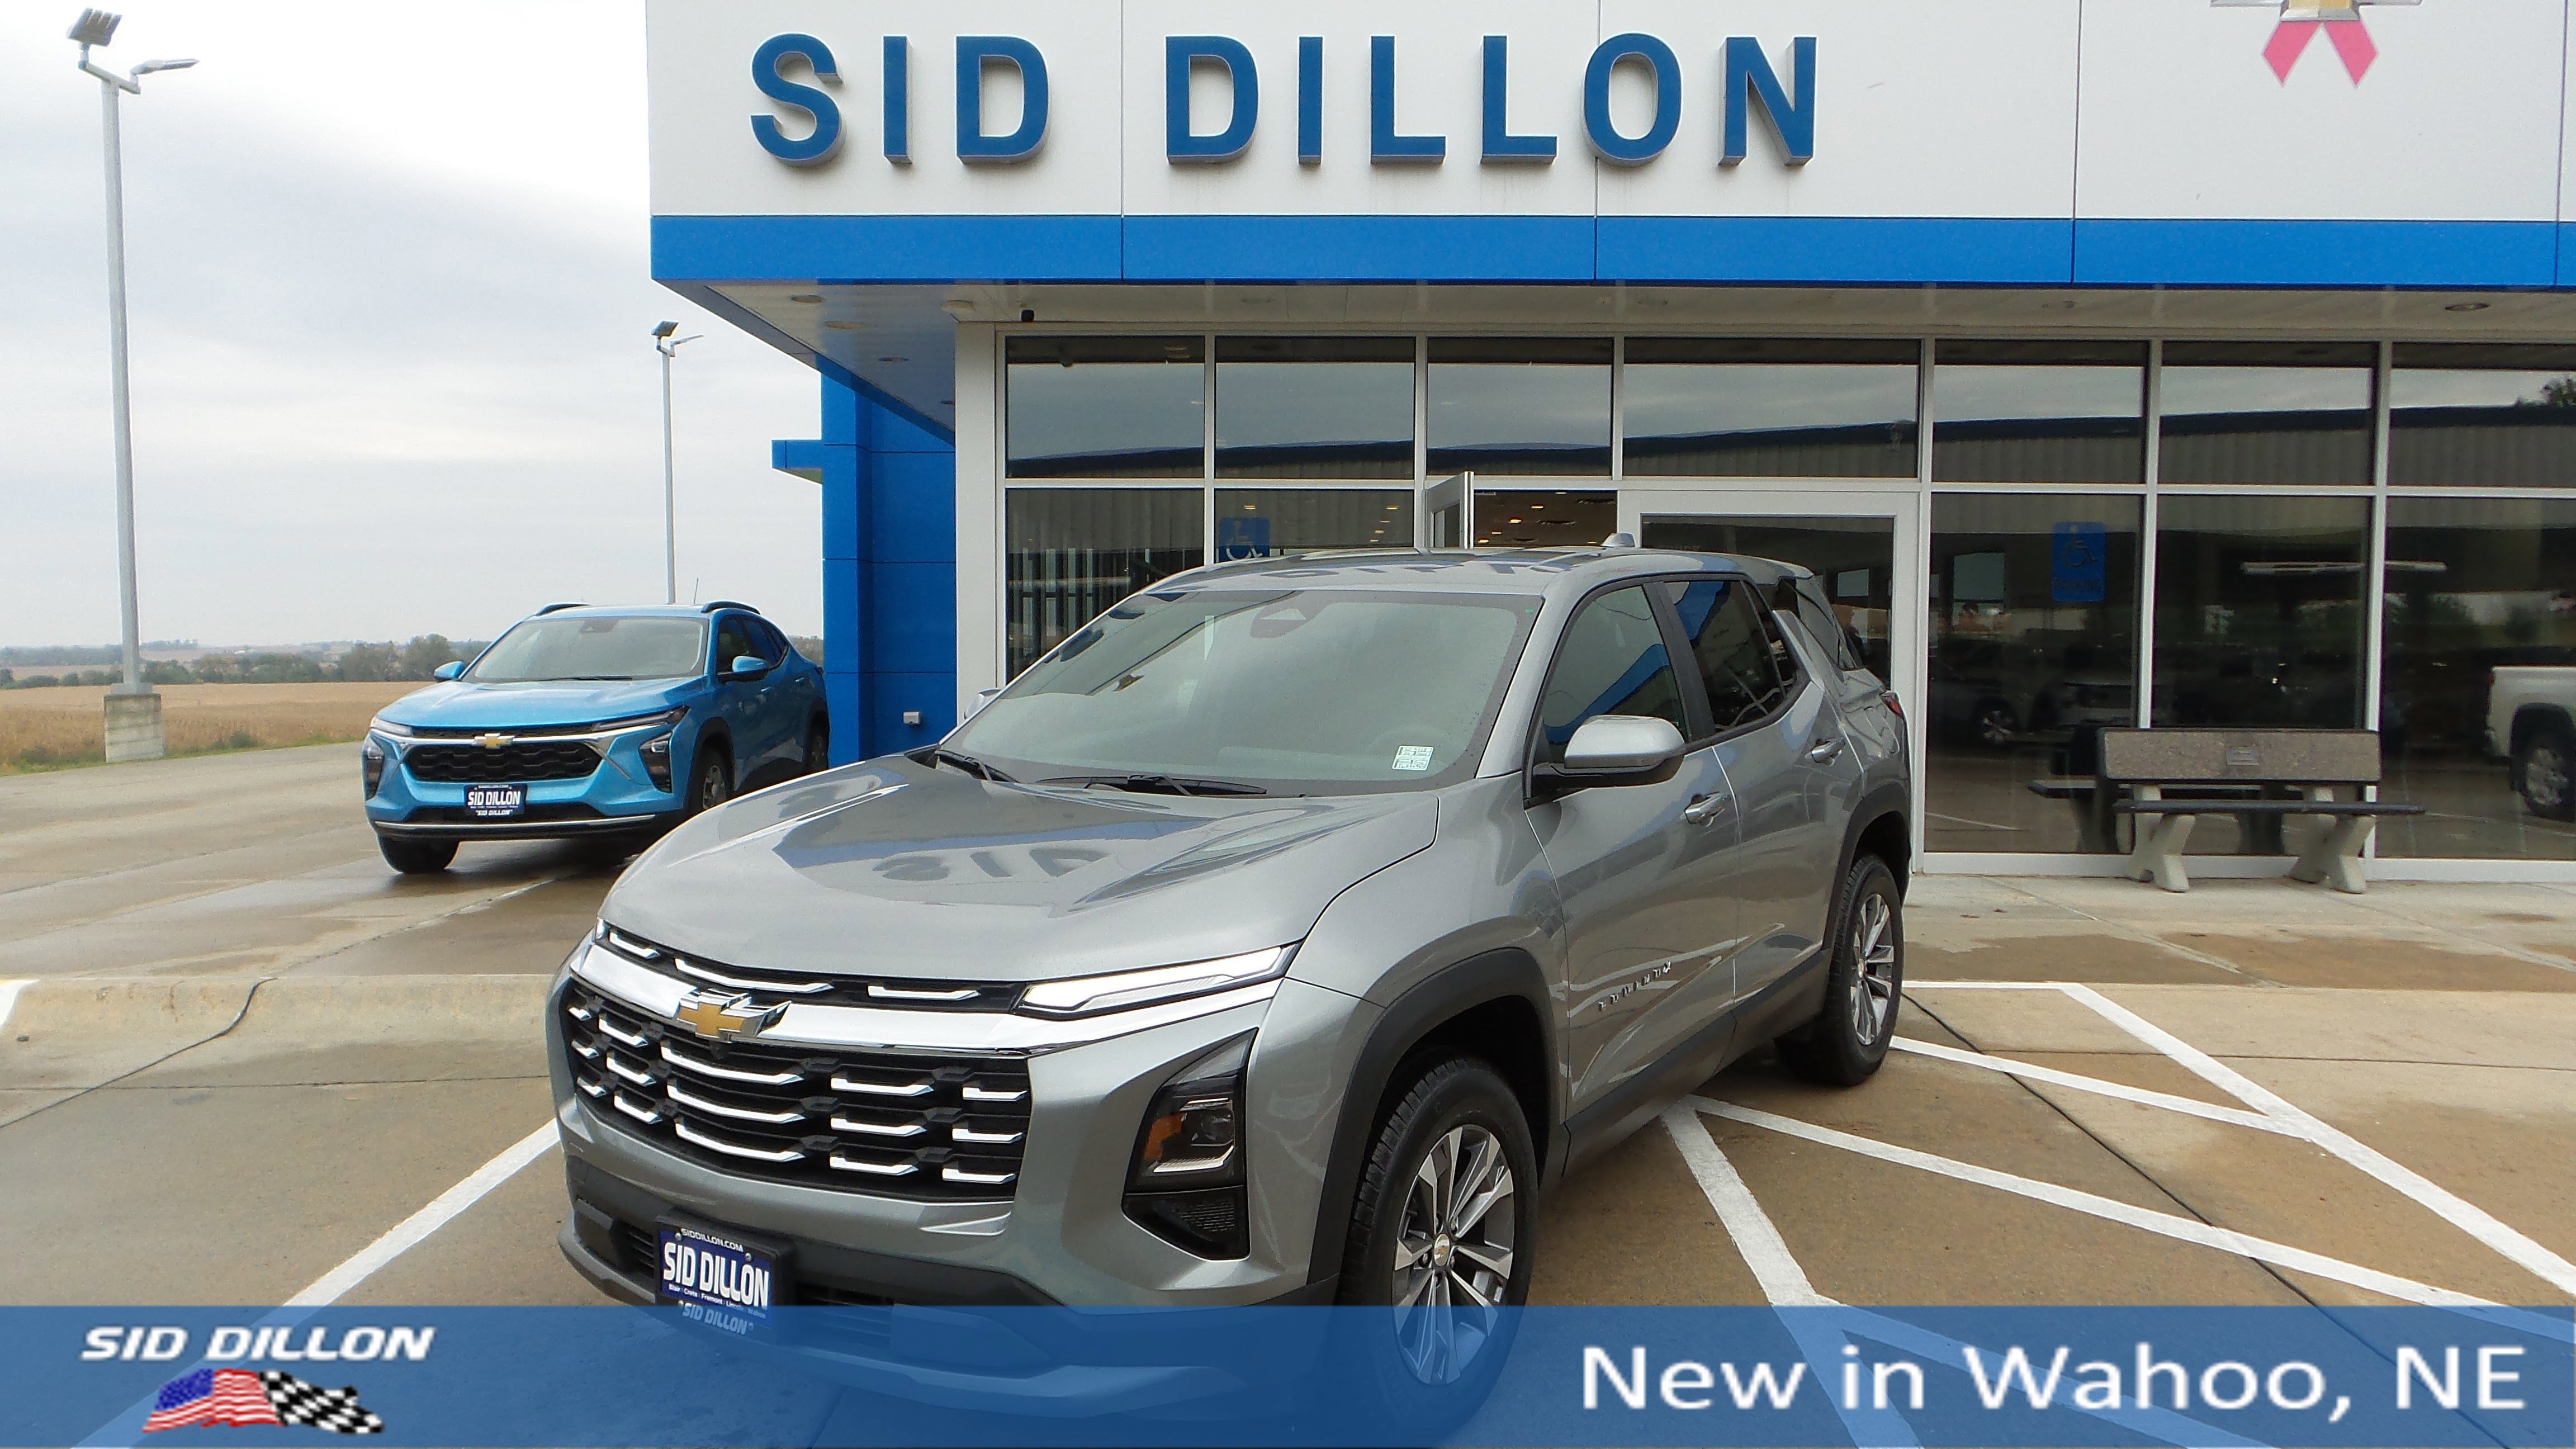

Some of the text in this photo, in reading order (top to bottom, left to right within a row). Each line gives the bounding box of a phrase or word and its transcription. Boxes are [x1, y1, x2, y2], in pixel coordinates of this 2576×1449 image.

[750, 31, 1818, 164] SID DILLON
[467, 790, 520, 806] SID DILLON
[680, 1228, 744, 1253] SIDDILLON.COM
[663, 1242, 770, 1310] SID DILLON
